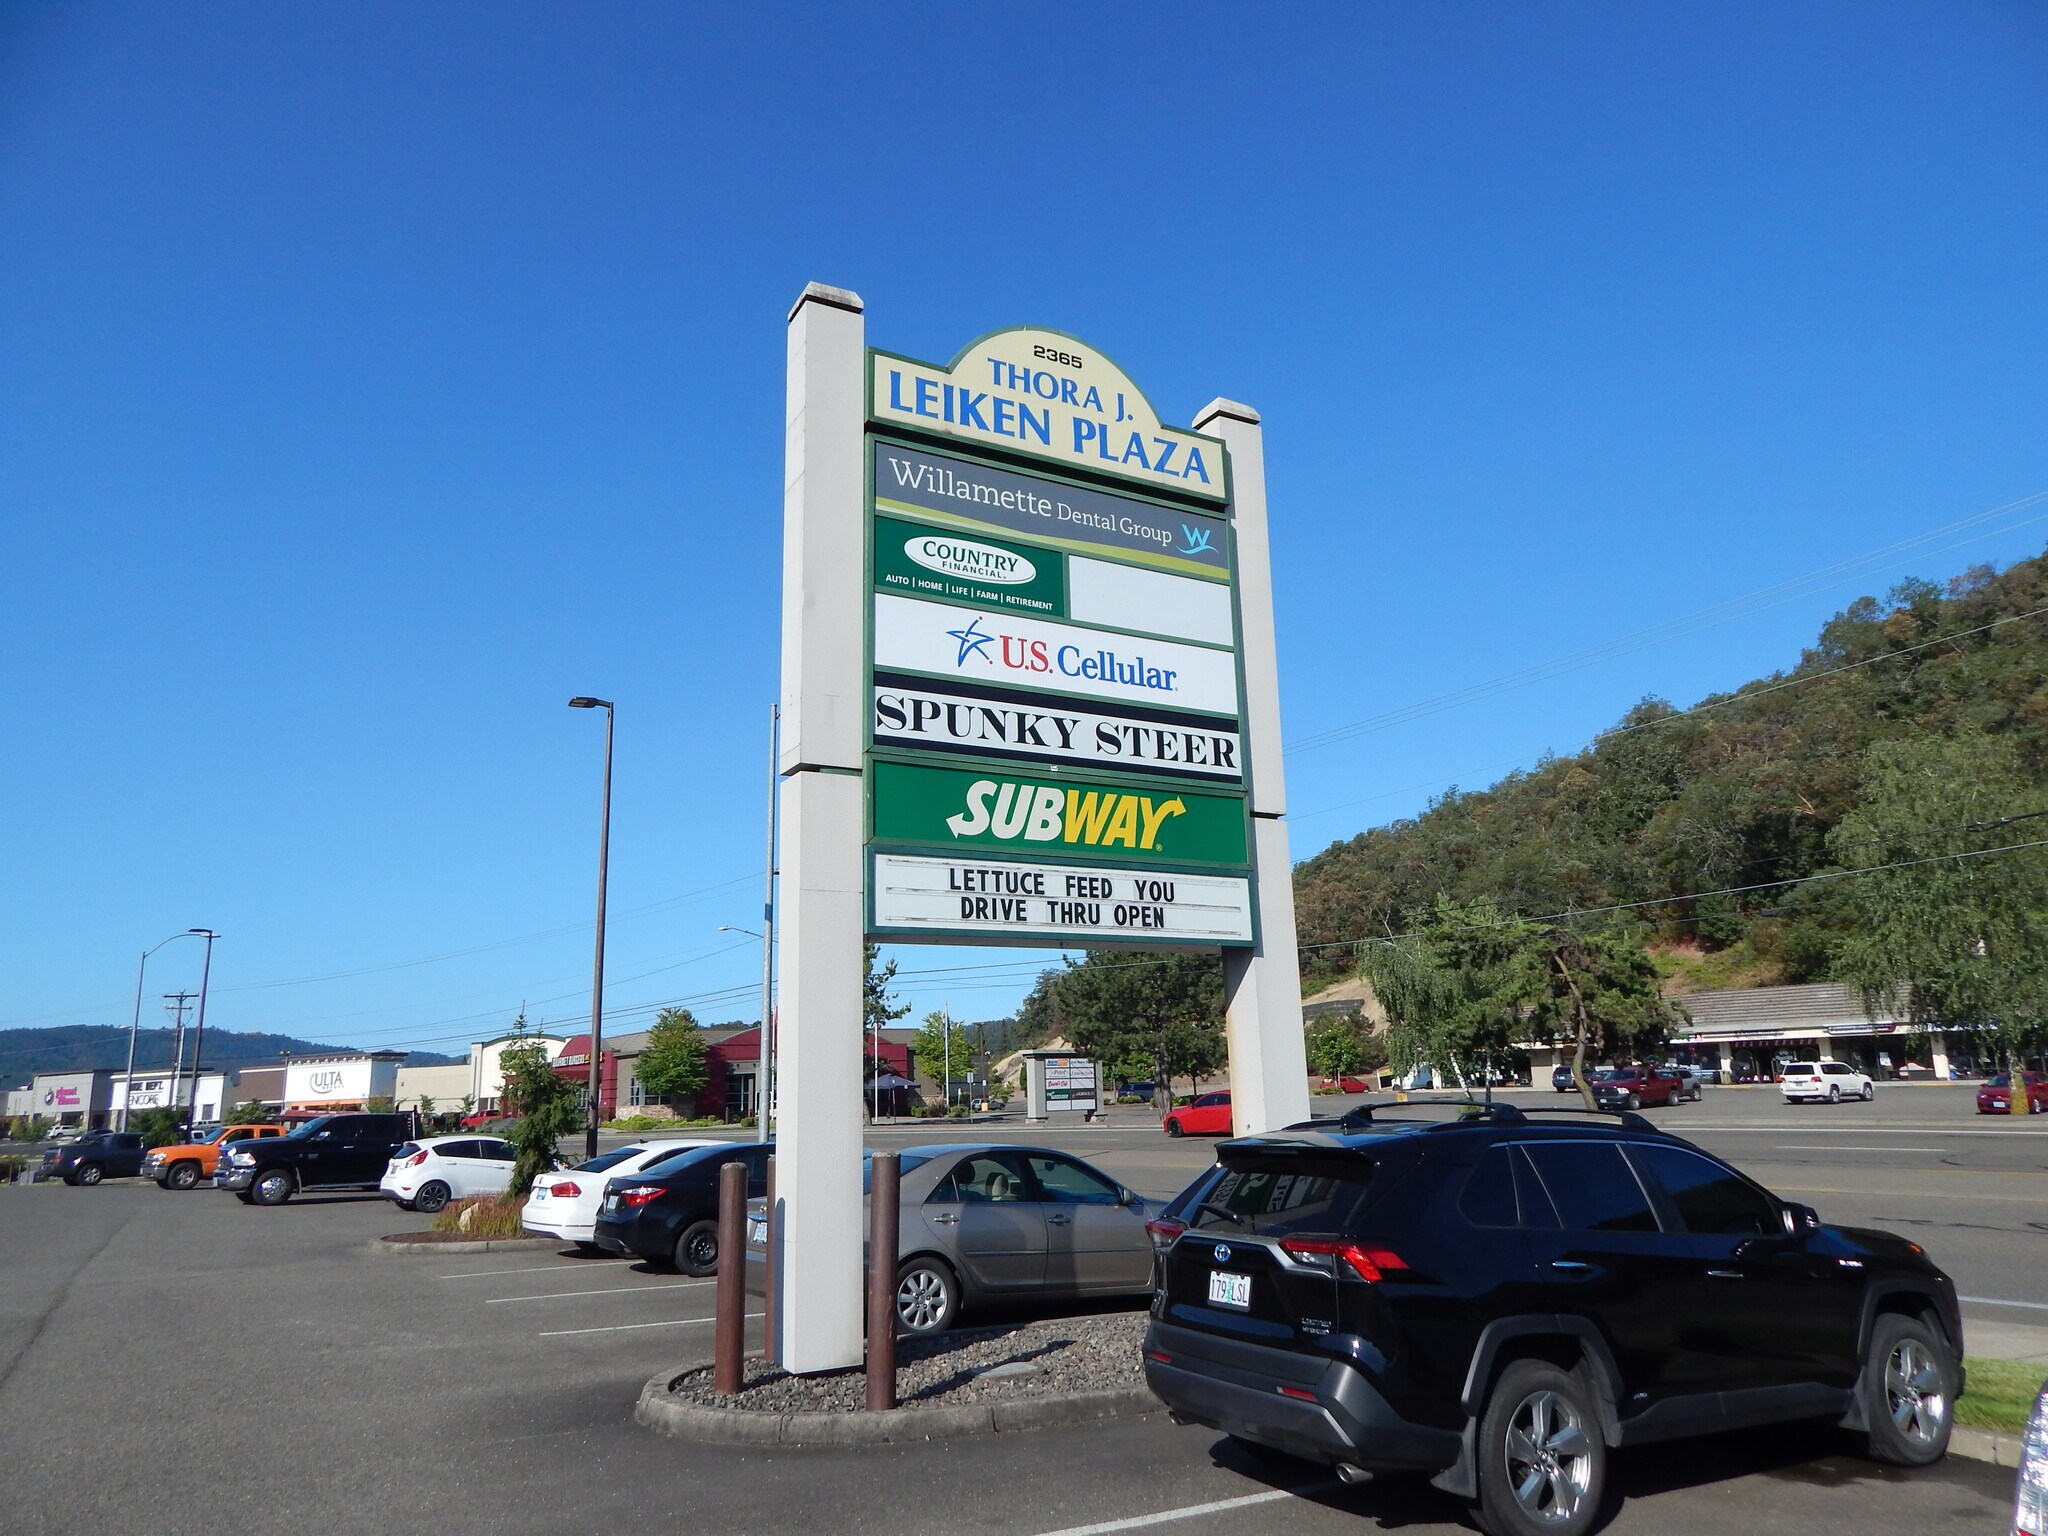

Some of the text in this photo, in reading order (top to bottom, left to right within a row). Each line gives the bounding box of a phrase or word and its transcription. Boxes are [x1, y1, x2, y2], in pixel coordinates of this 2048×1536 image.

[1033, 345, 1083, 369] 2365
[987, 357, 1134, 422] THORA J.
[889, 370, 1211, 485] LEIKEN PLAZA
[888, 458, 1173, 547] Willamette Dental Group
[922, 540, 1019, 573] COUNTRY
[885, 574, 1053, 611] AUTO HOME LIFE FARM RETIREMENT
[1000, 635, 1177, 691] U.S. Cellular
[876, 694, 1236, 769] SPUNKY STEER
[946, 780, 1187, 849] SUBWAY
[950, 868, 1174, 902] LETTUCE FEED YOU
[961, 896, 1164, 928] DRIVE THRU OPEN
[314, 1071, 343, 1087] ULTA
[1211, 1278, 1248, 1304] 179 LSL
